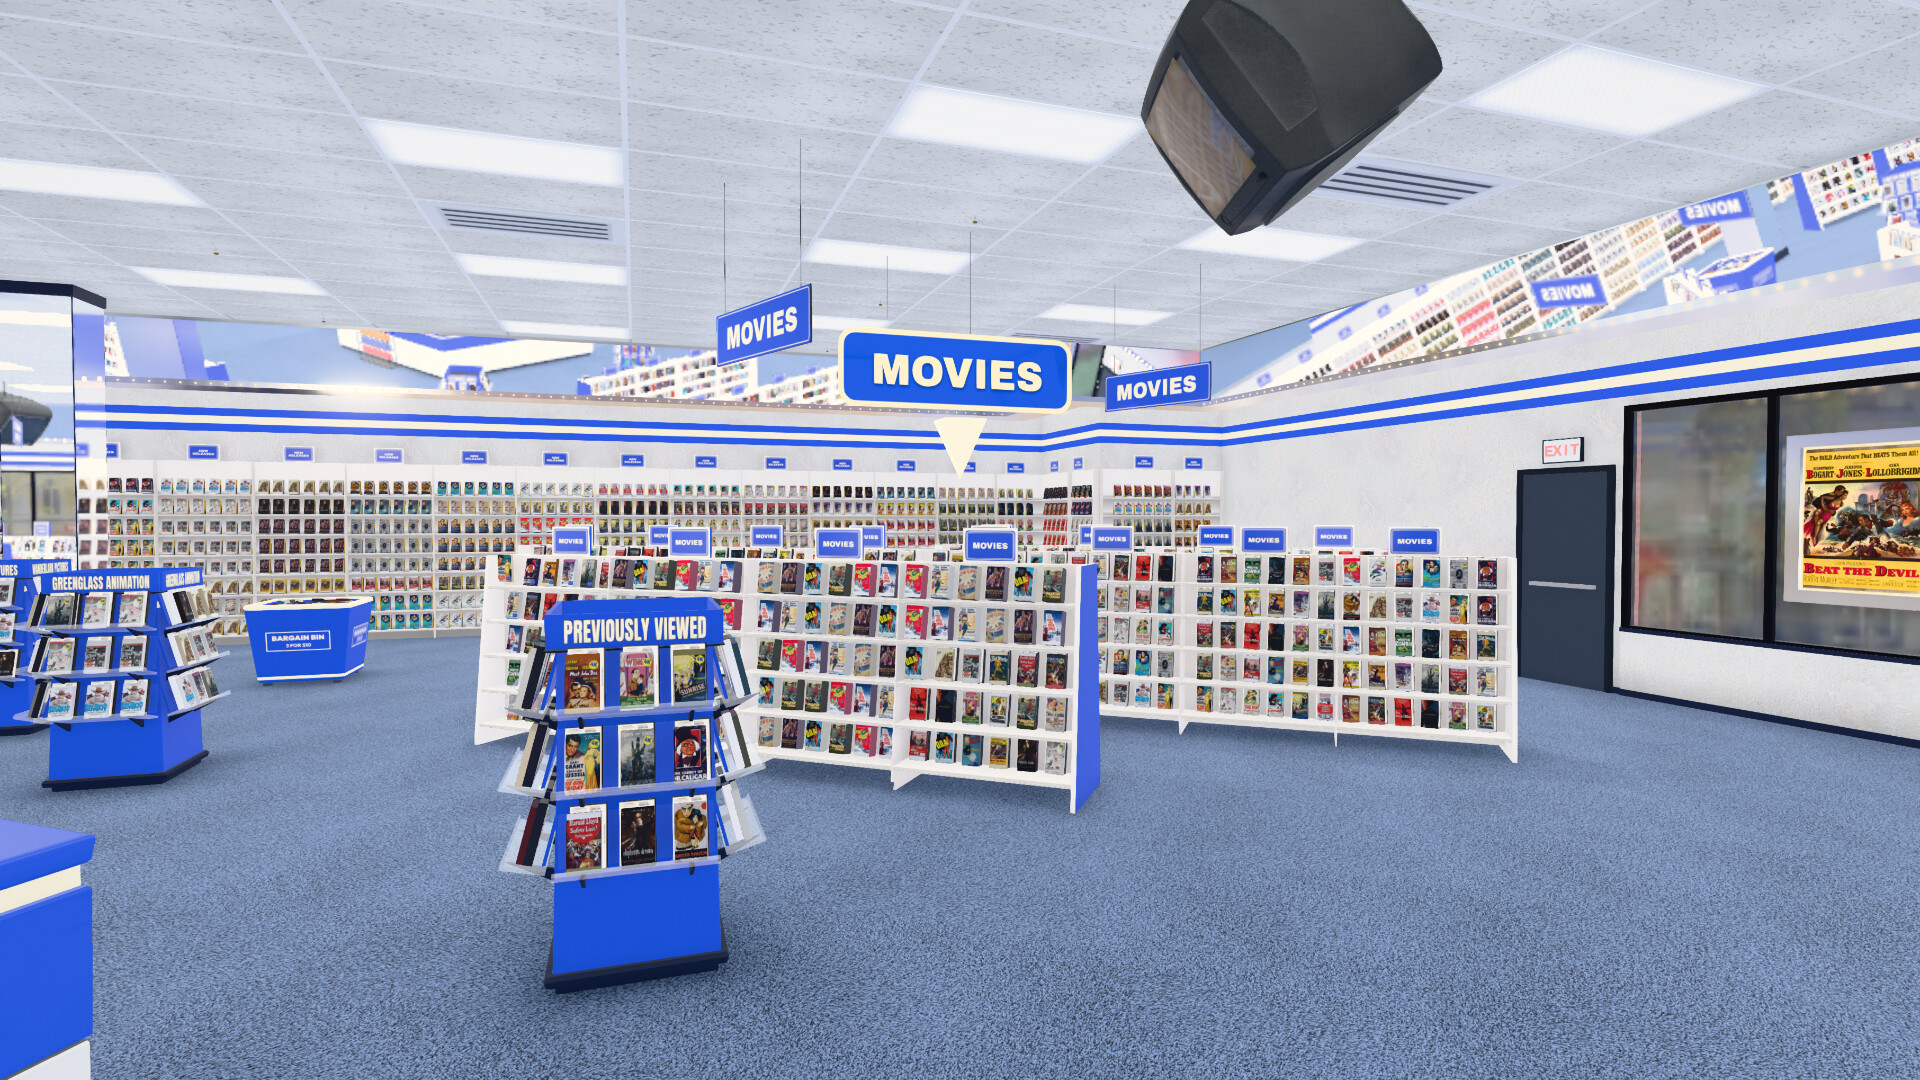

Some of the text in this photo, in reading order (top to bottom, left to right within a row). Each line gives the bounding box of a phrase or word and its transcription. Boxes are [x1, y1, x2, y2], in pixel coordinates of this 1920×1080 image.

[726, 306, 798, 350] MOVIES
[873, 353, 1042, 392] MOVIES
[1116, 375, 1196, 402] MOVIES
[1544, 443, 1579, 457] EXIT
[1806, 469, 1834, 479] BOGART
[1836, 468, 1862, 478] JONES
[1804, 563, 1919, 578] BEAT THE DEVIL
[52, 575, 150, 590] GREENGLASS ANIMATION
[564, 616, 707, 644] PREVIOUSLY VIEWED
[272, 634, 309, 642] BARGAIN
[625, 659, 643, 667] WIN
[681, 683, 706, 696] SUNRISE
[568, 817, 598, 827] Harold Lloyd
